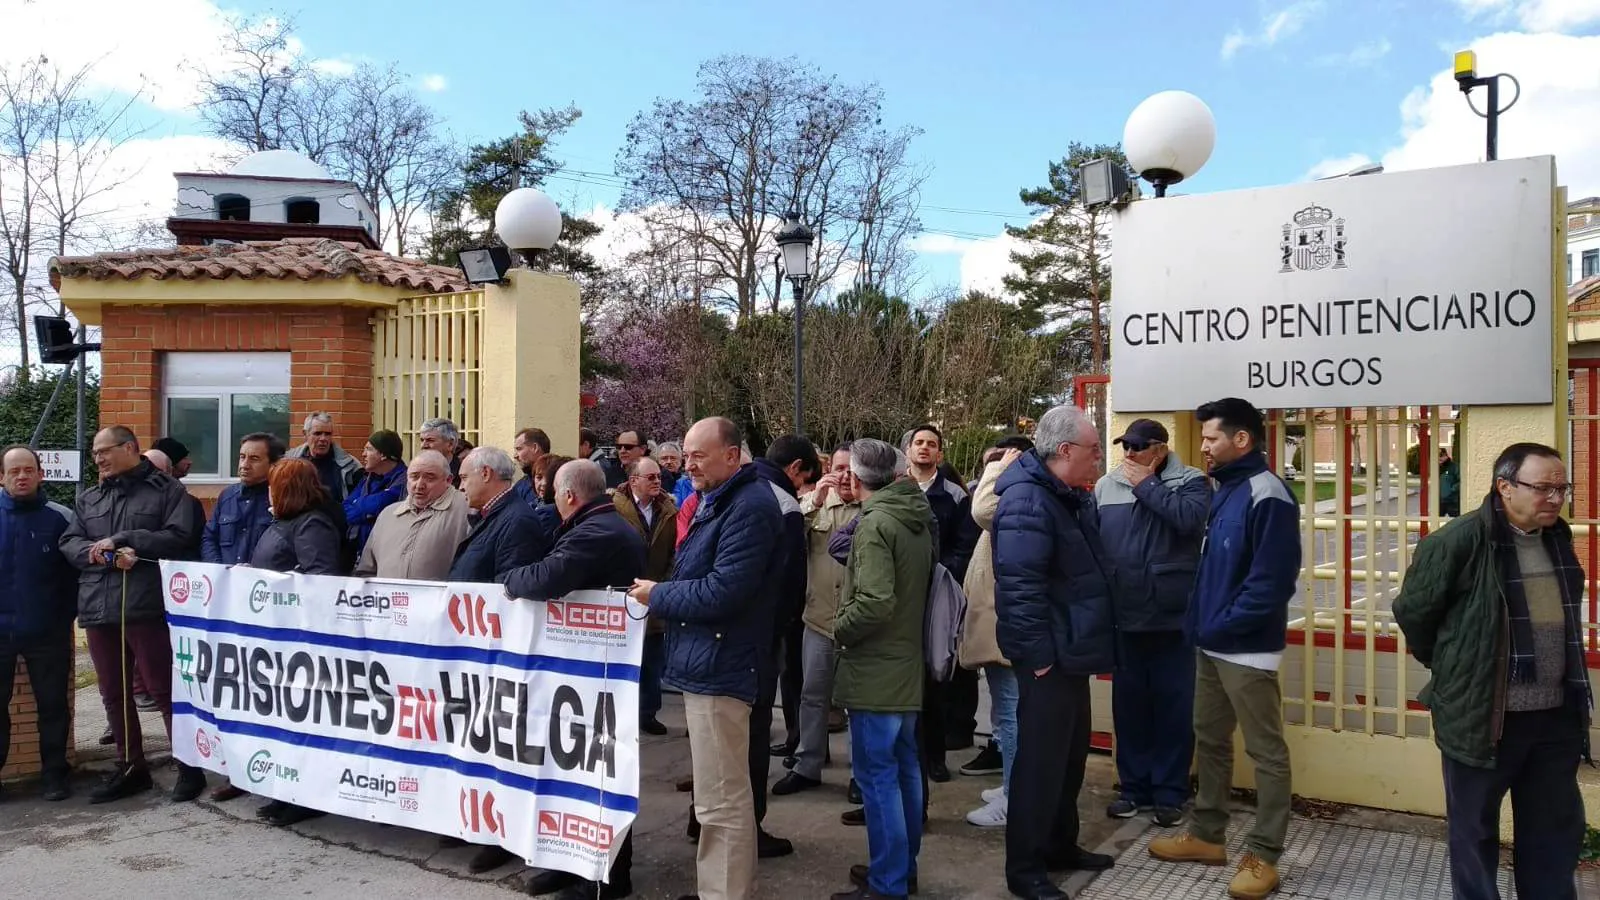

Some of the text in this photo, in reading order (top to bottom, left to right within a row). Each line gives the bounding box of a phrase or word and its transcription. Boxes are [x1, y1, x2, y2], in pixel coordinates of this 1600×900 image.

[1123, 289, 1537, 347] CENTRO PENITENCIARIO
[1247, 357, 1383, 389] BURGOS
[335, 589, 391, 614] Acaip
[448, 593, 502, 639] CIG
[569, 607, 623, 627] CCOO
[176, 636, 616, 779] #PRISIONES EN HUELGA
[339, 768, 396, 797] Acaip
[566, 818, 610, 846] CCOO
